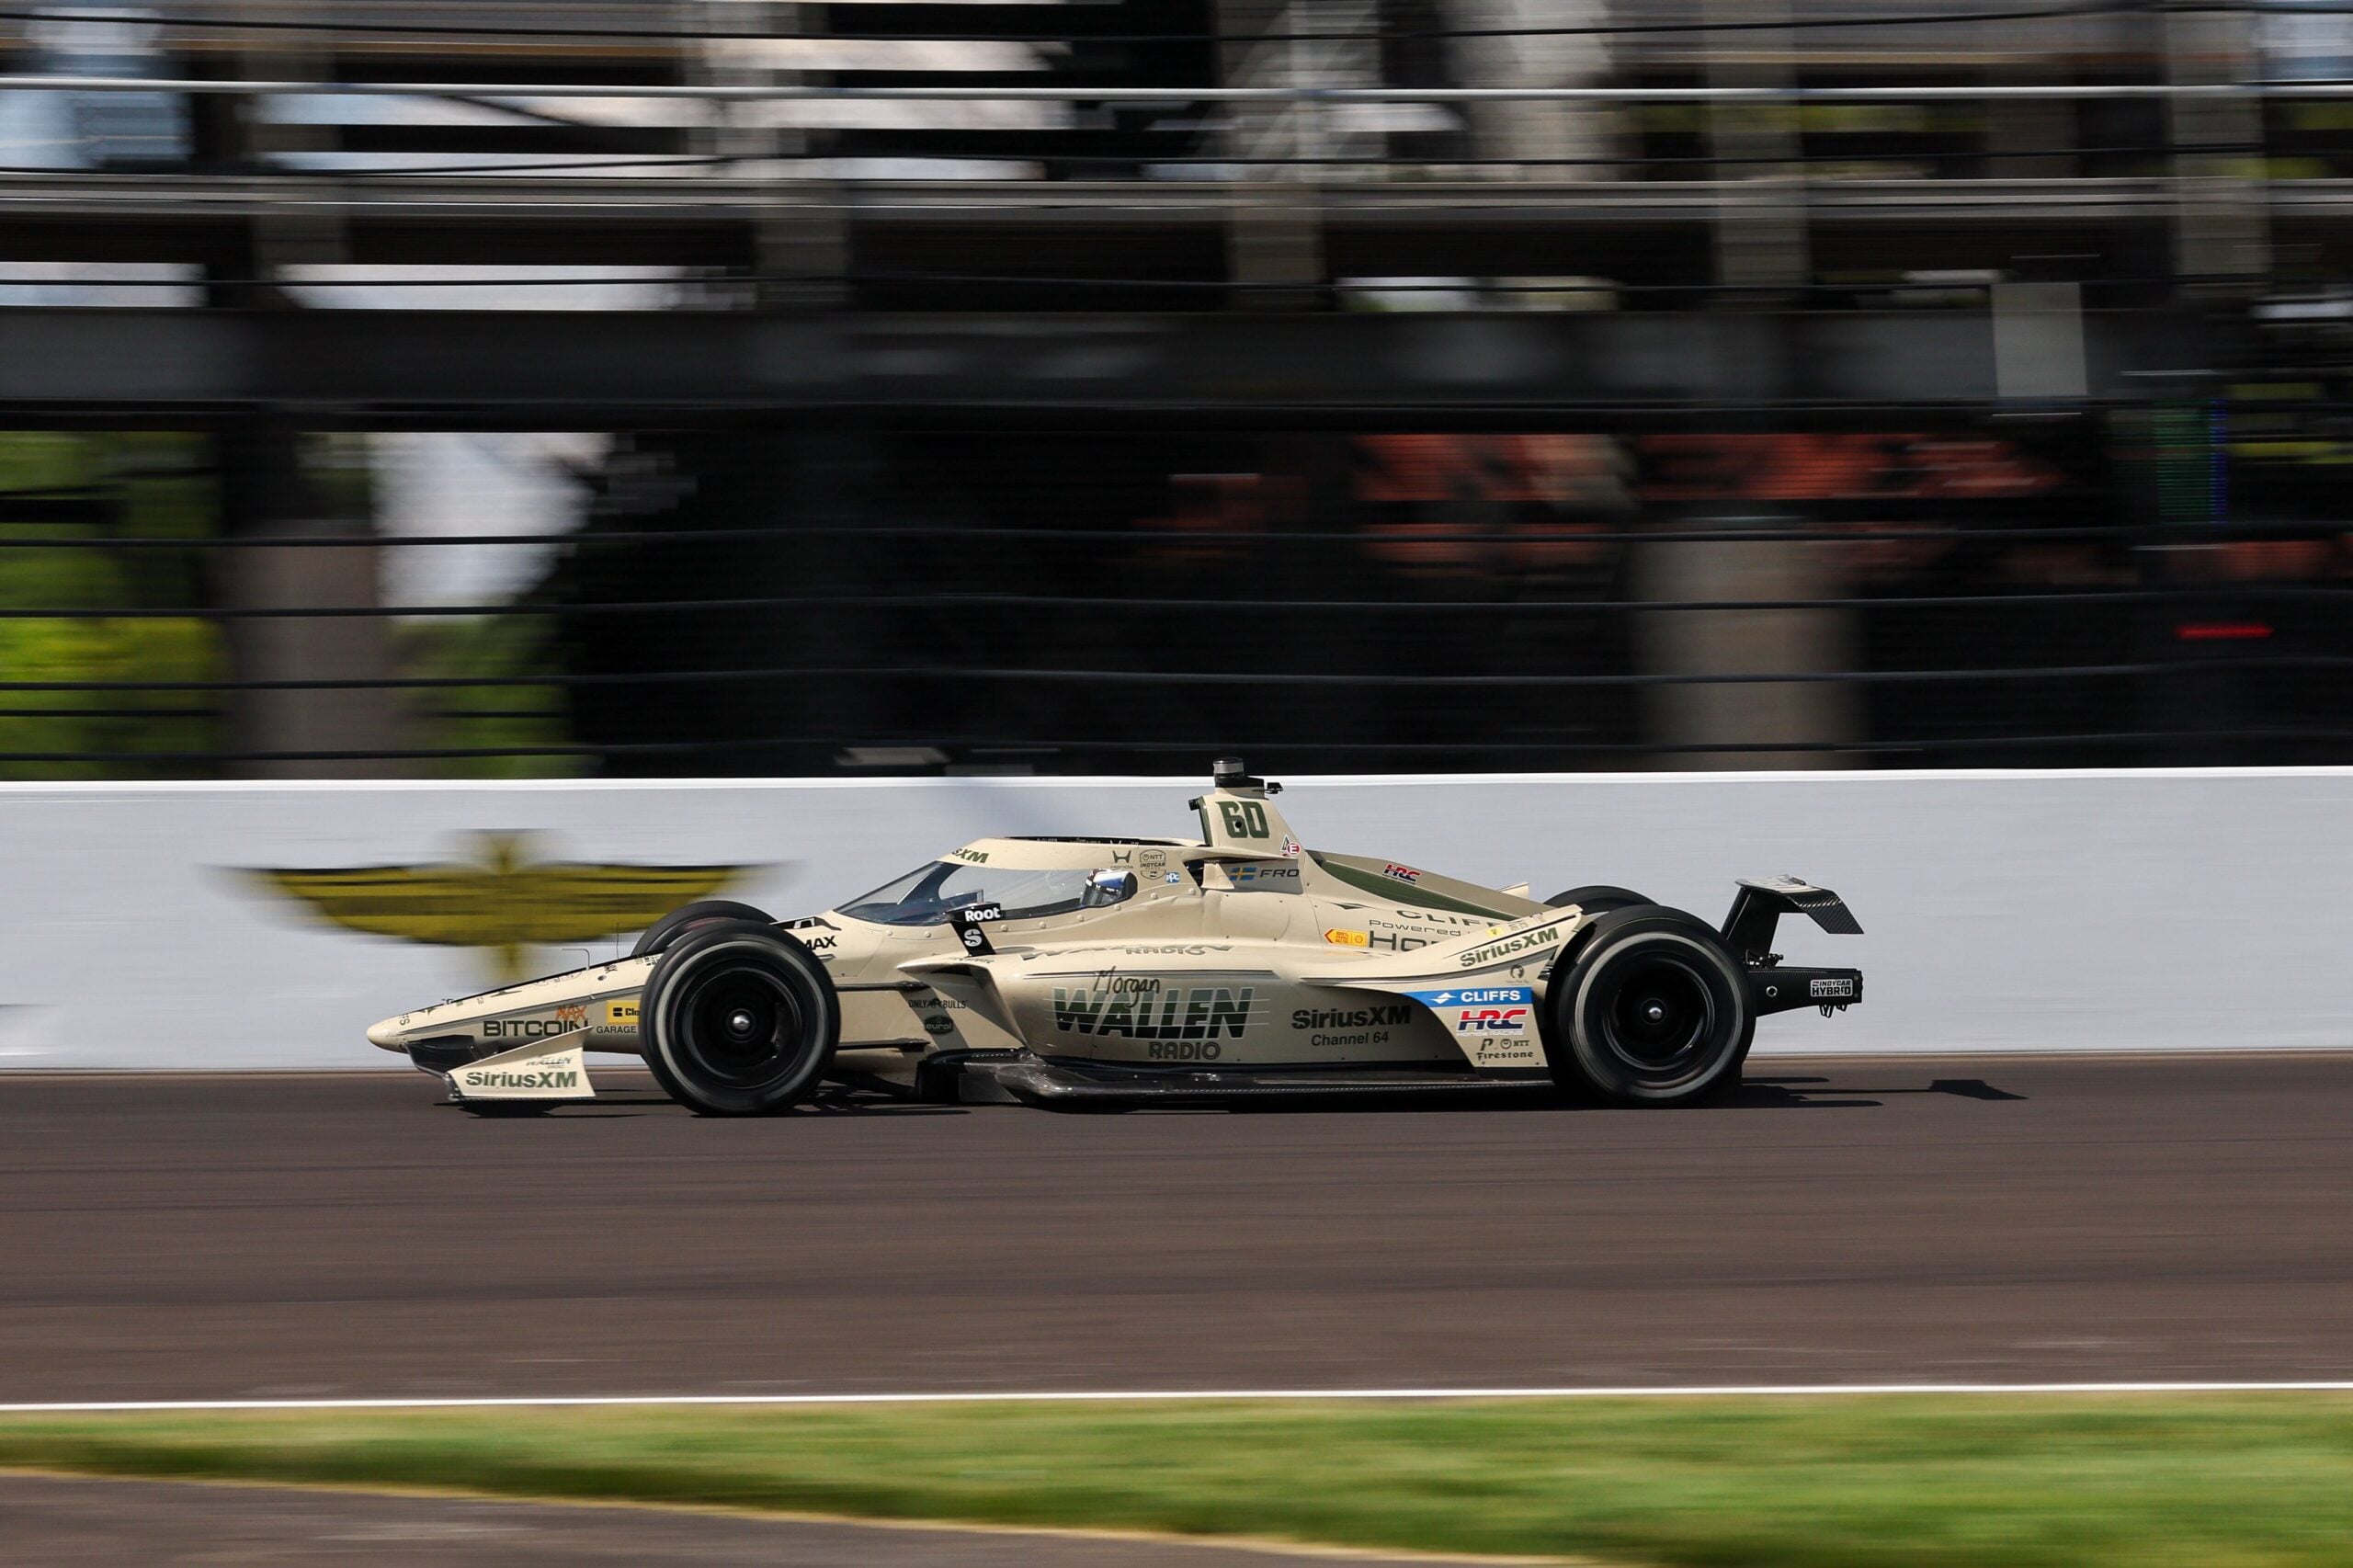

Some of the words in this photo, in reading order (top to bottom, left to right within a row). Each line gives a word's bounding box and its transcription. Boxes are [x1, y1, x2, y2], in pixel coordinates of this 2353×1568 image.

[1214, 801, 1270, 838] 60
[1165, 872, 1180, 882] PPG
[965, 907, 1001, 922] Root
[1369, 919, 1461, 937] Powered
[1369, 930, 1439, 952] Ho
[1460, 926, 1559, 967] SiriusXM
[1094, 966, 1161, 1008] Morgan
[908, 999, 928, 1008] ONLY
[941, 1000, 967, 1009] BULLS
[1461, 990, 1521, 1003] CLIFFS
[1052, 987, 1255, 1040] WALLEN
[1291, 1006, 1411, 1029] SiriusXM
[1458, 1009, 1529, 1031] HRC
[483, 1019, 588, 1037] BITCOIN
[597, 1026, 637, 1034] GARAGE
[1312, 1033, 1369, 1046] Channel
[1372, 1031, 1389, 1043] 64
[1149, 1041, 1221, 1060] RADIO
[1476, 1051, 1534, 1061] Firestone
[466, 1072, 577, 1088] SiriusXM
